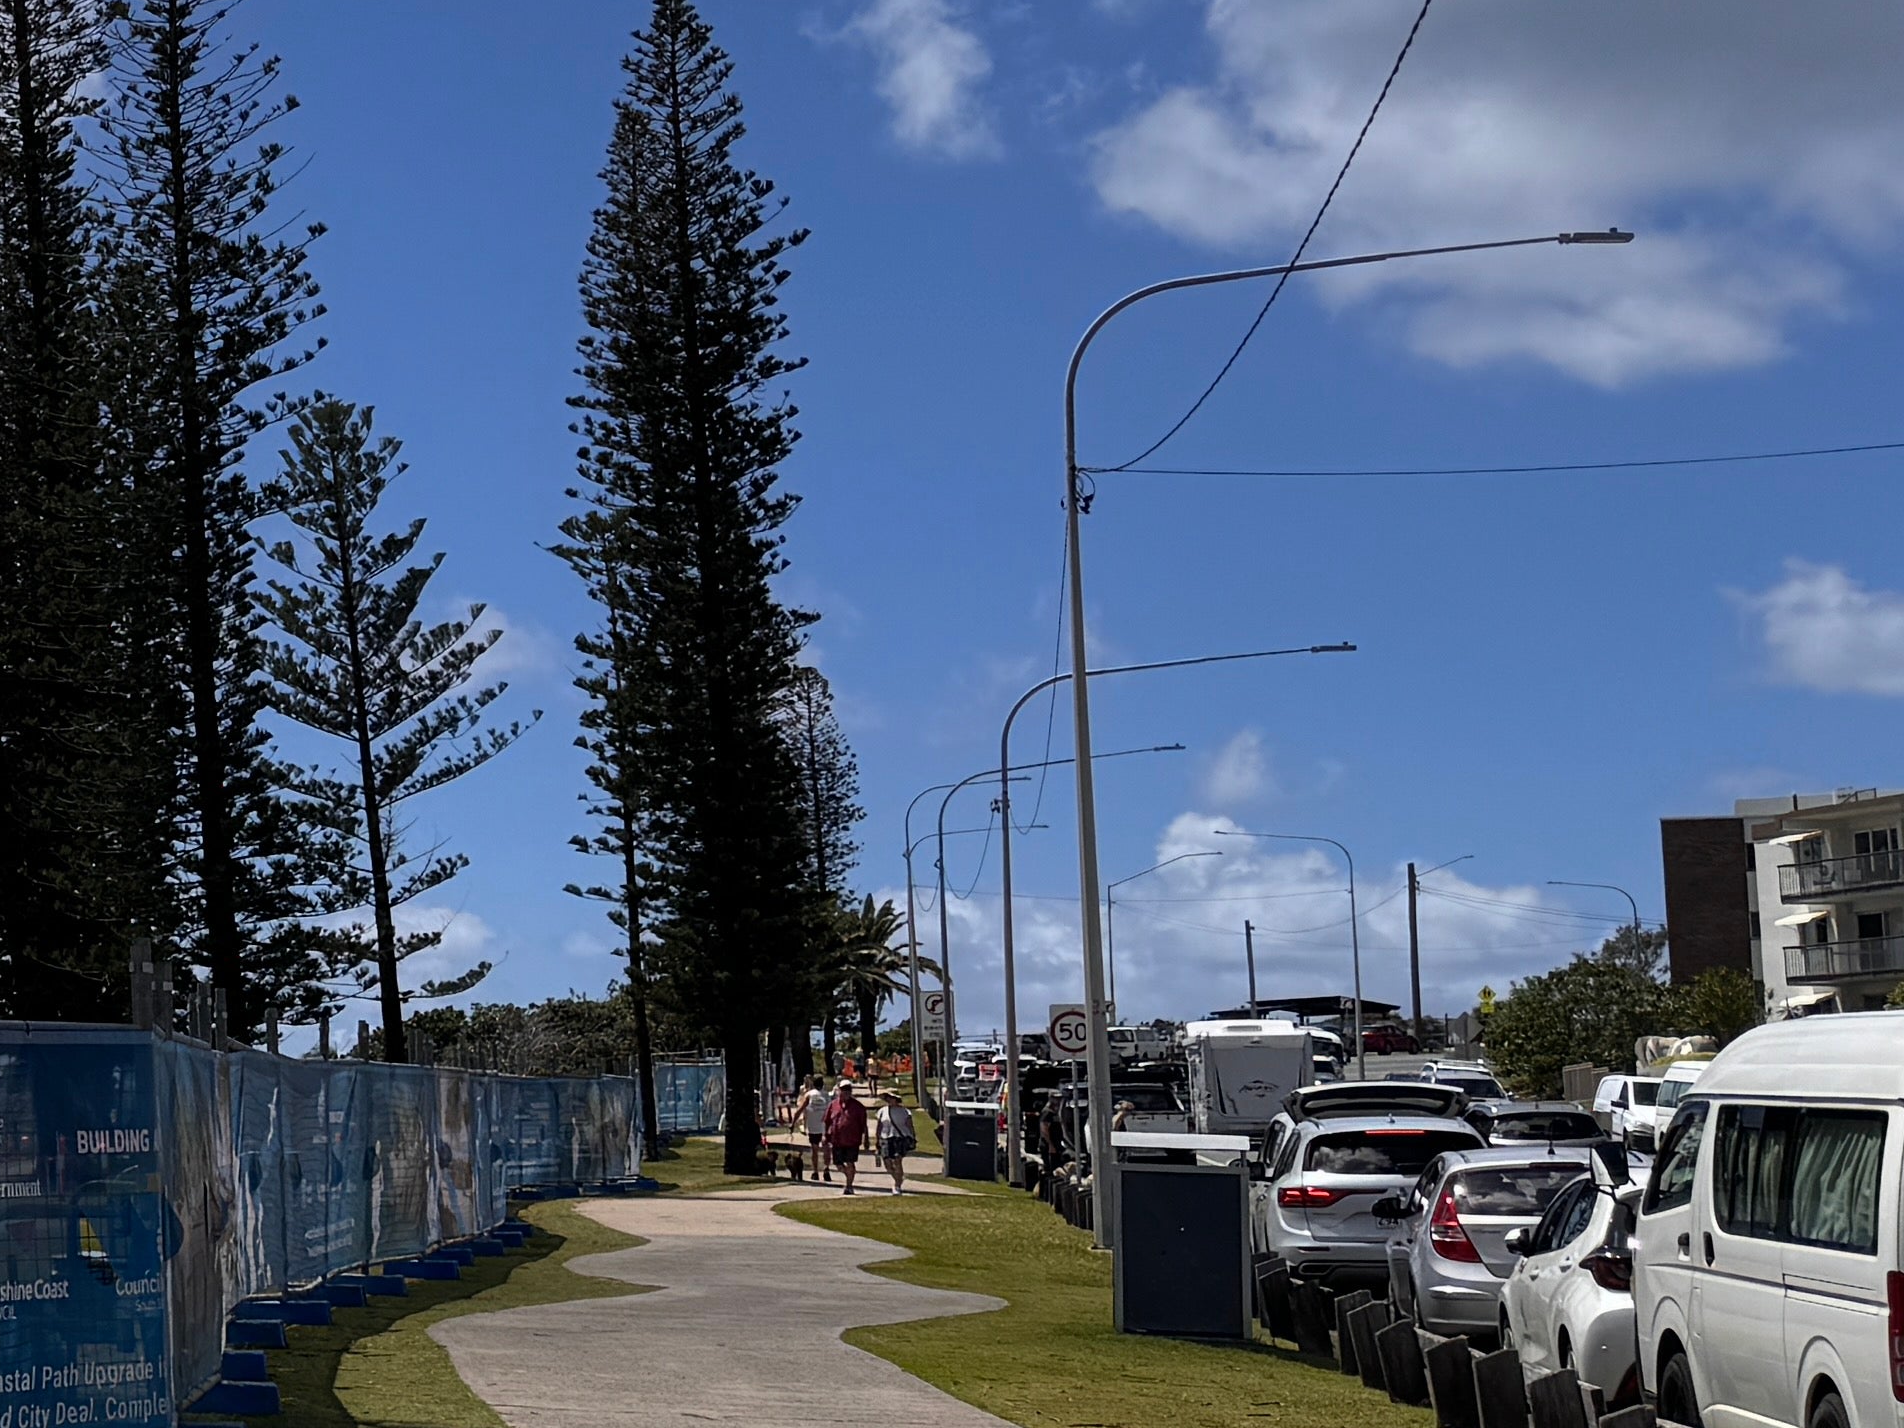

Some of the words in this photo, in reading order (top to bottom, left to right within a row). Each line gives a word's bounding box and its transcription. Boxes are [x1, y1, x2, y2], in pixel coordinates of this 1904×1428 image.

[1059, 1023, 1087, 1041] 50
[76, 1128, 150, 1154] BUILDING
[42, 1362, 79, 1390] Path
[84, 1356, 154, 1389] Upgrade
[55, 1397, 99, 1426] Deal.
